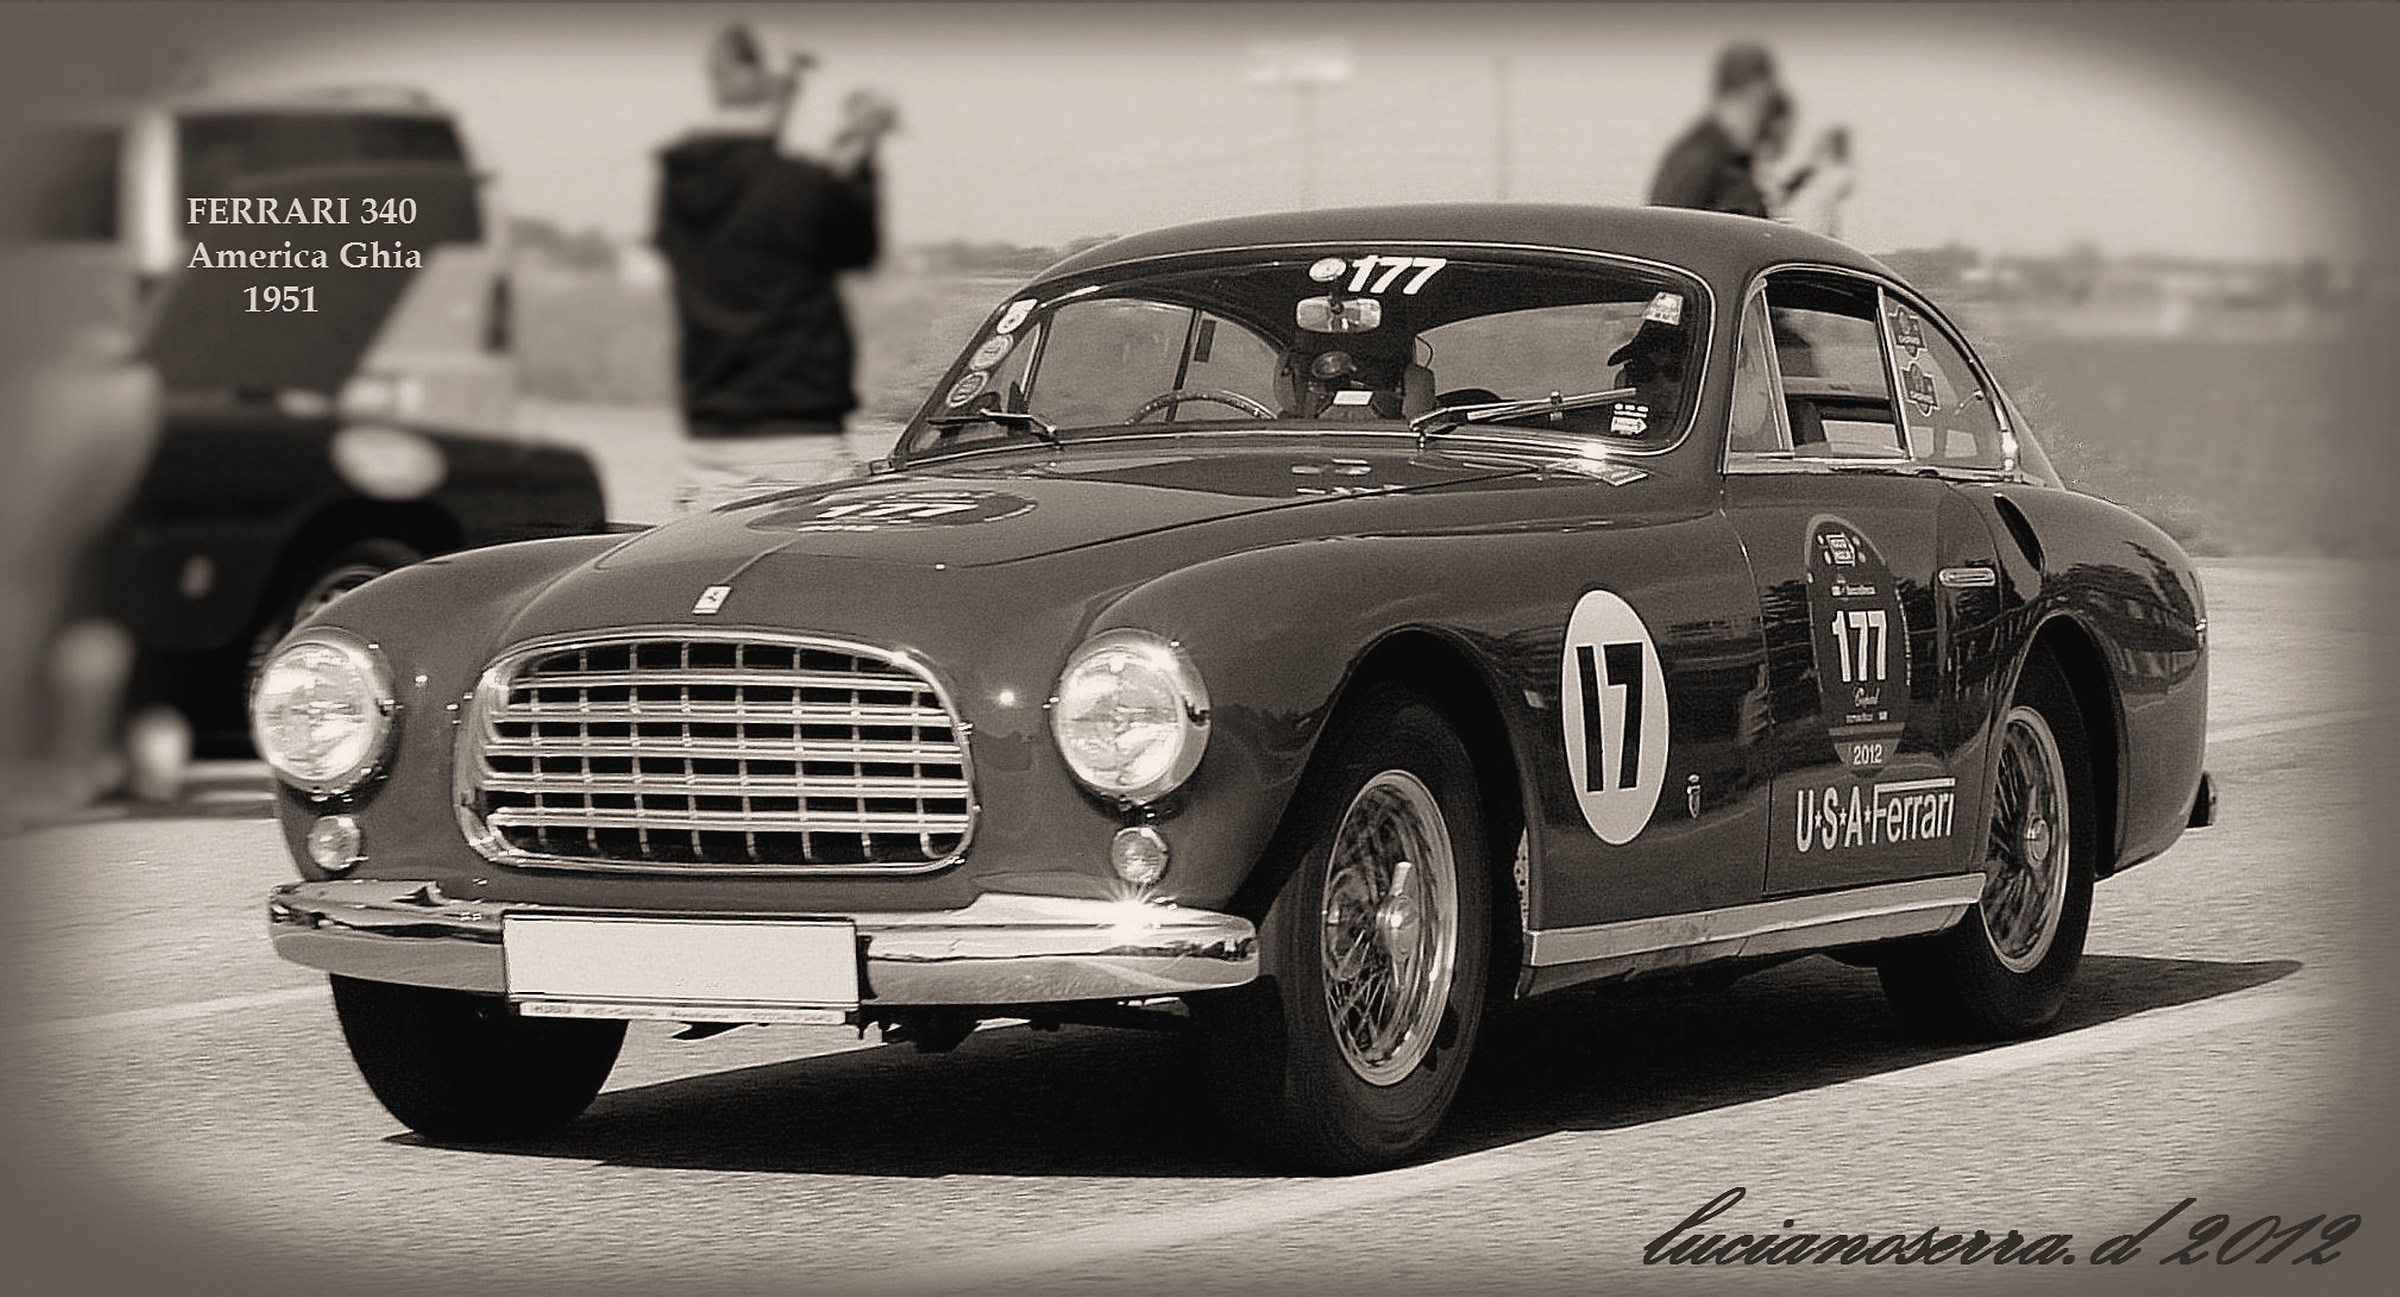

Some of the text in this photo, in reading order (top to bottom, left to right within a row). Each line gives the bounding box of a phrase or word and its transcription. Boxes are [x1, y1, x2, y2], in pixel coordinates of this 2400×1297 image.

[1348, 255, 1447, 295] 177
[1831, 610, 1887, 682] 177
[1576, 642, 1643, 793] 17
[1853, 744, 1883, 766] 2012
